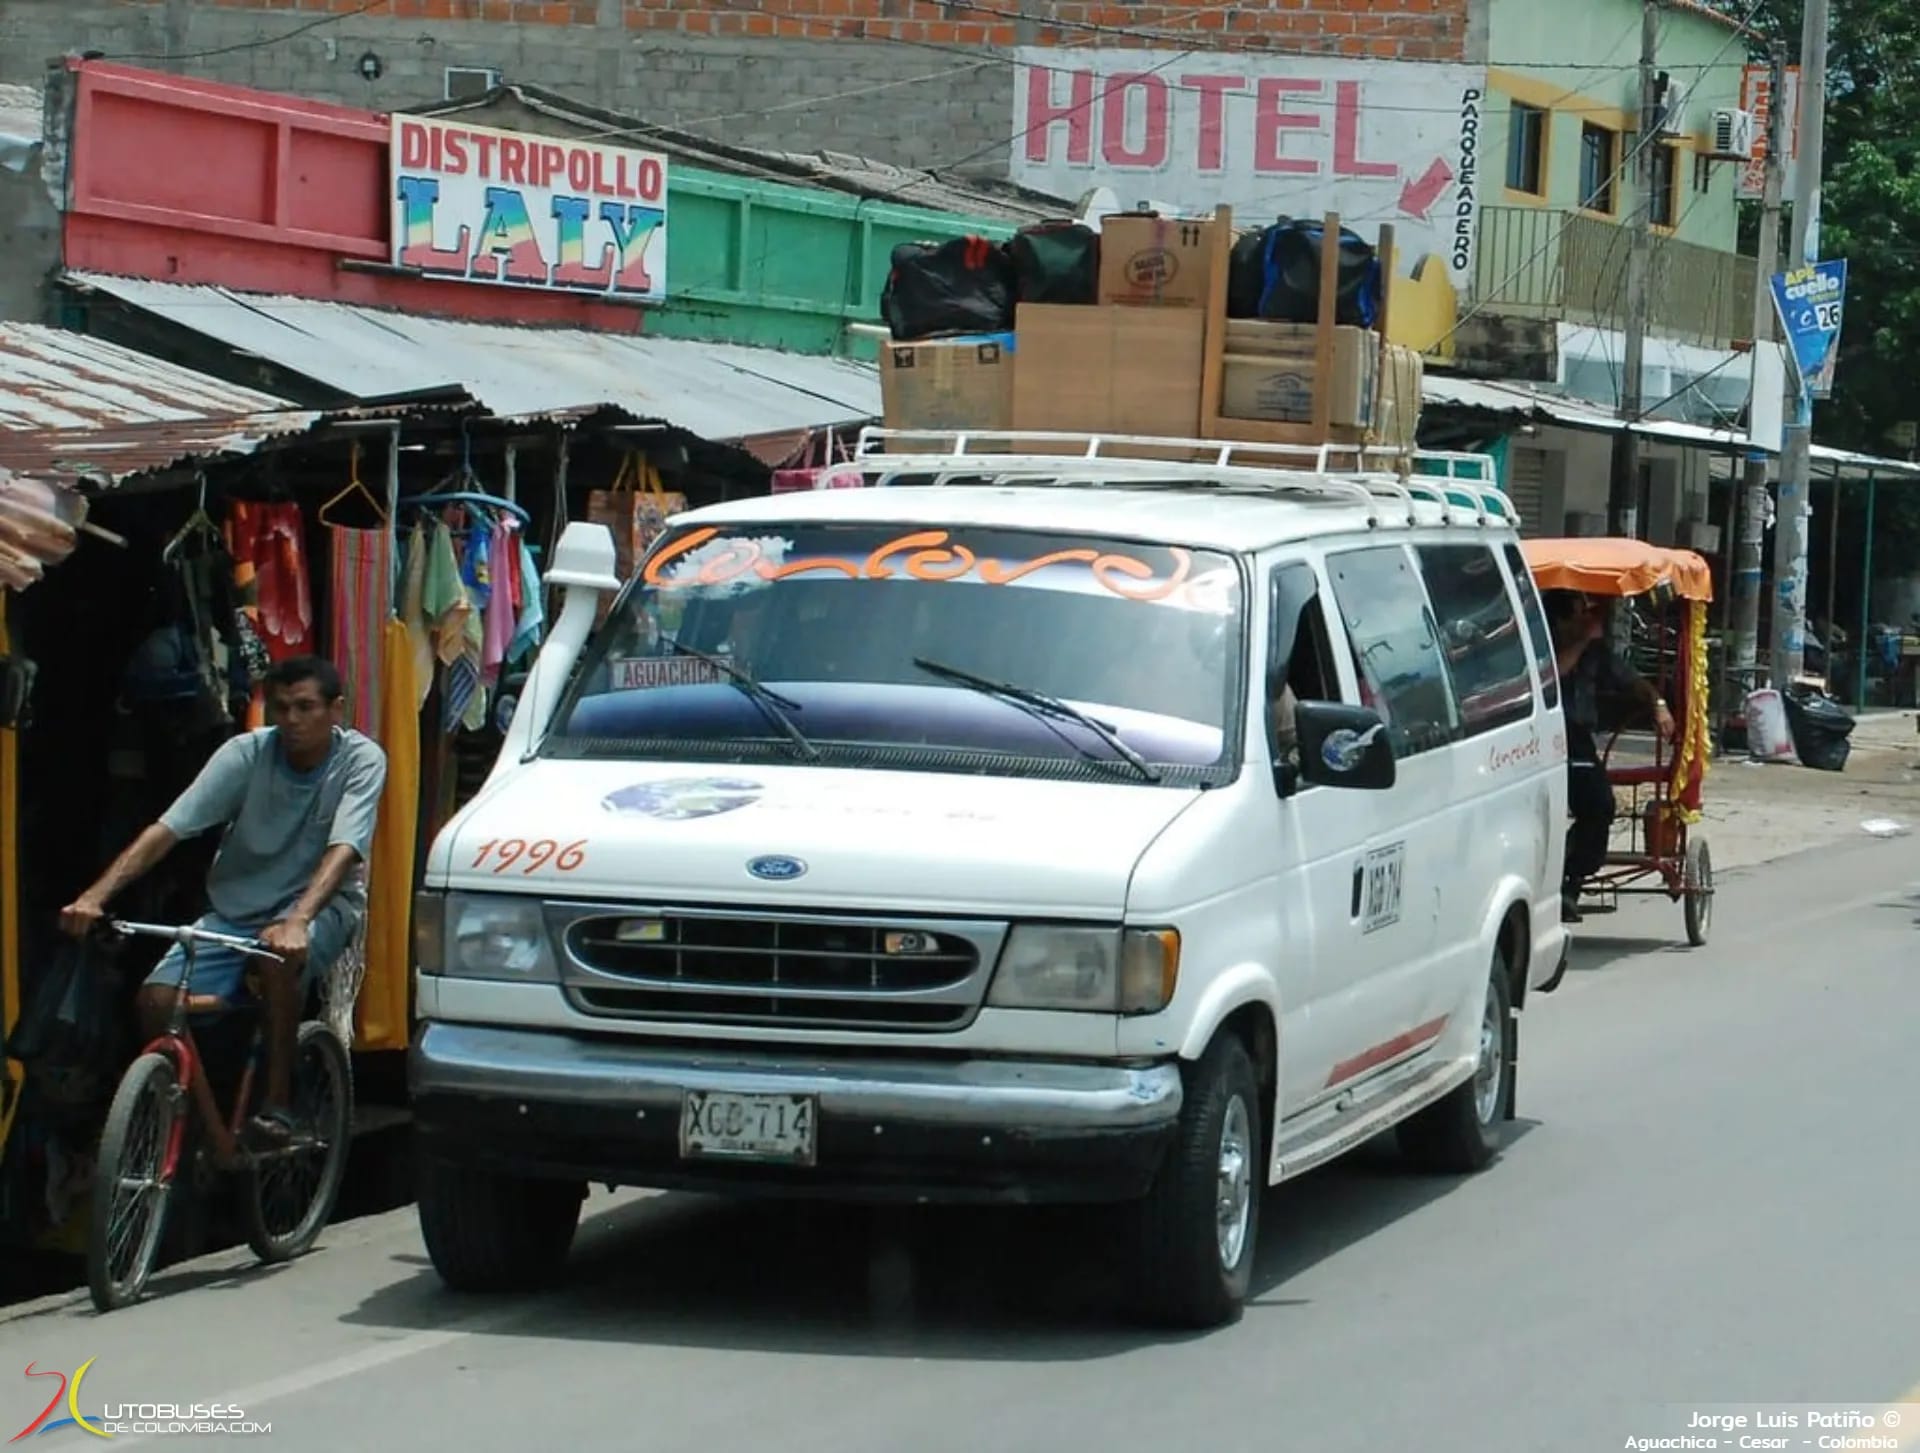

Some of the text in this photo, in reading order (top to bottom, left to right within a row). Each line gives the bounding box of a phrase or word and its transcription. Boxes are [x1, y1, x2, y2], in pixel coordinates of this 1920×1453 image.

[400, 121, 662, 201] DISTRIPOLLO
[1025, 65, 1399, 178] HOTEL
[1452, 88, 1480, 270] PARQUEADERO
[397, 174, 665, 293] LALY
[1818, 304, 1841, 328] 26
[624, 660, 719, 689] AGUACHICA
[471, 839, 588, 875] 1996
